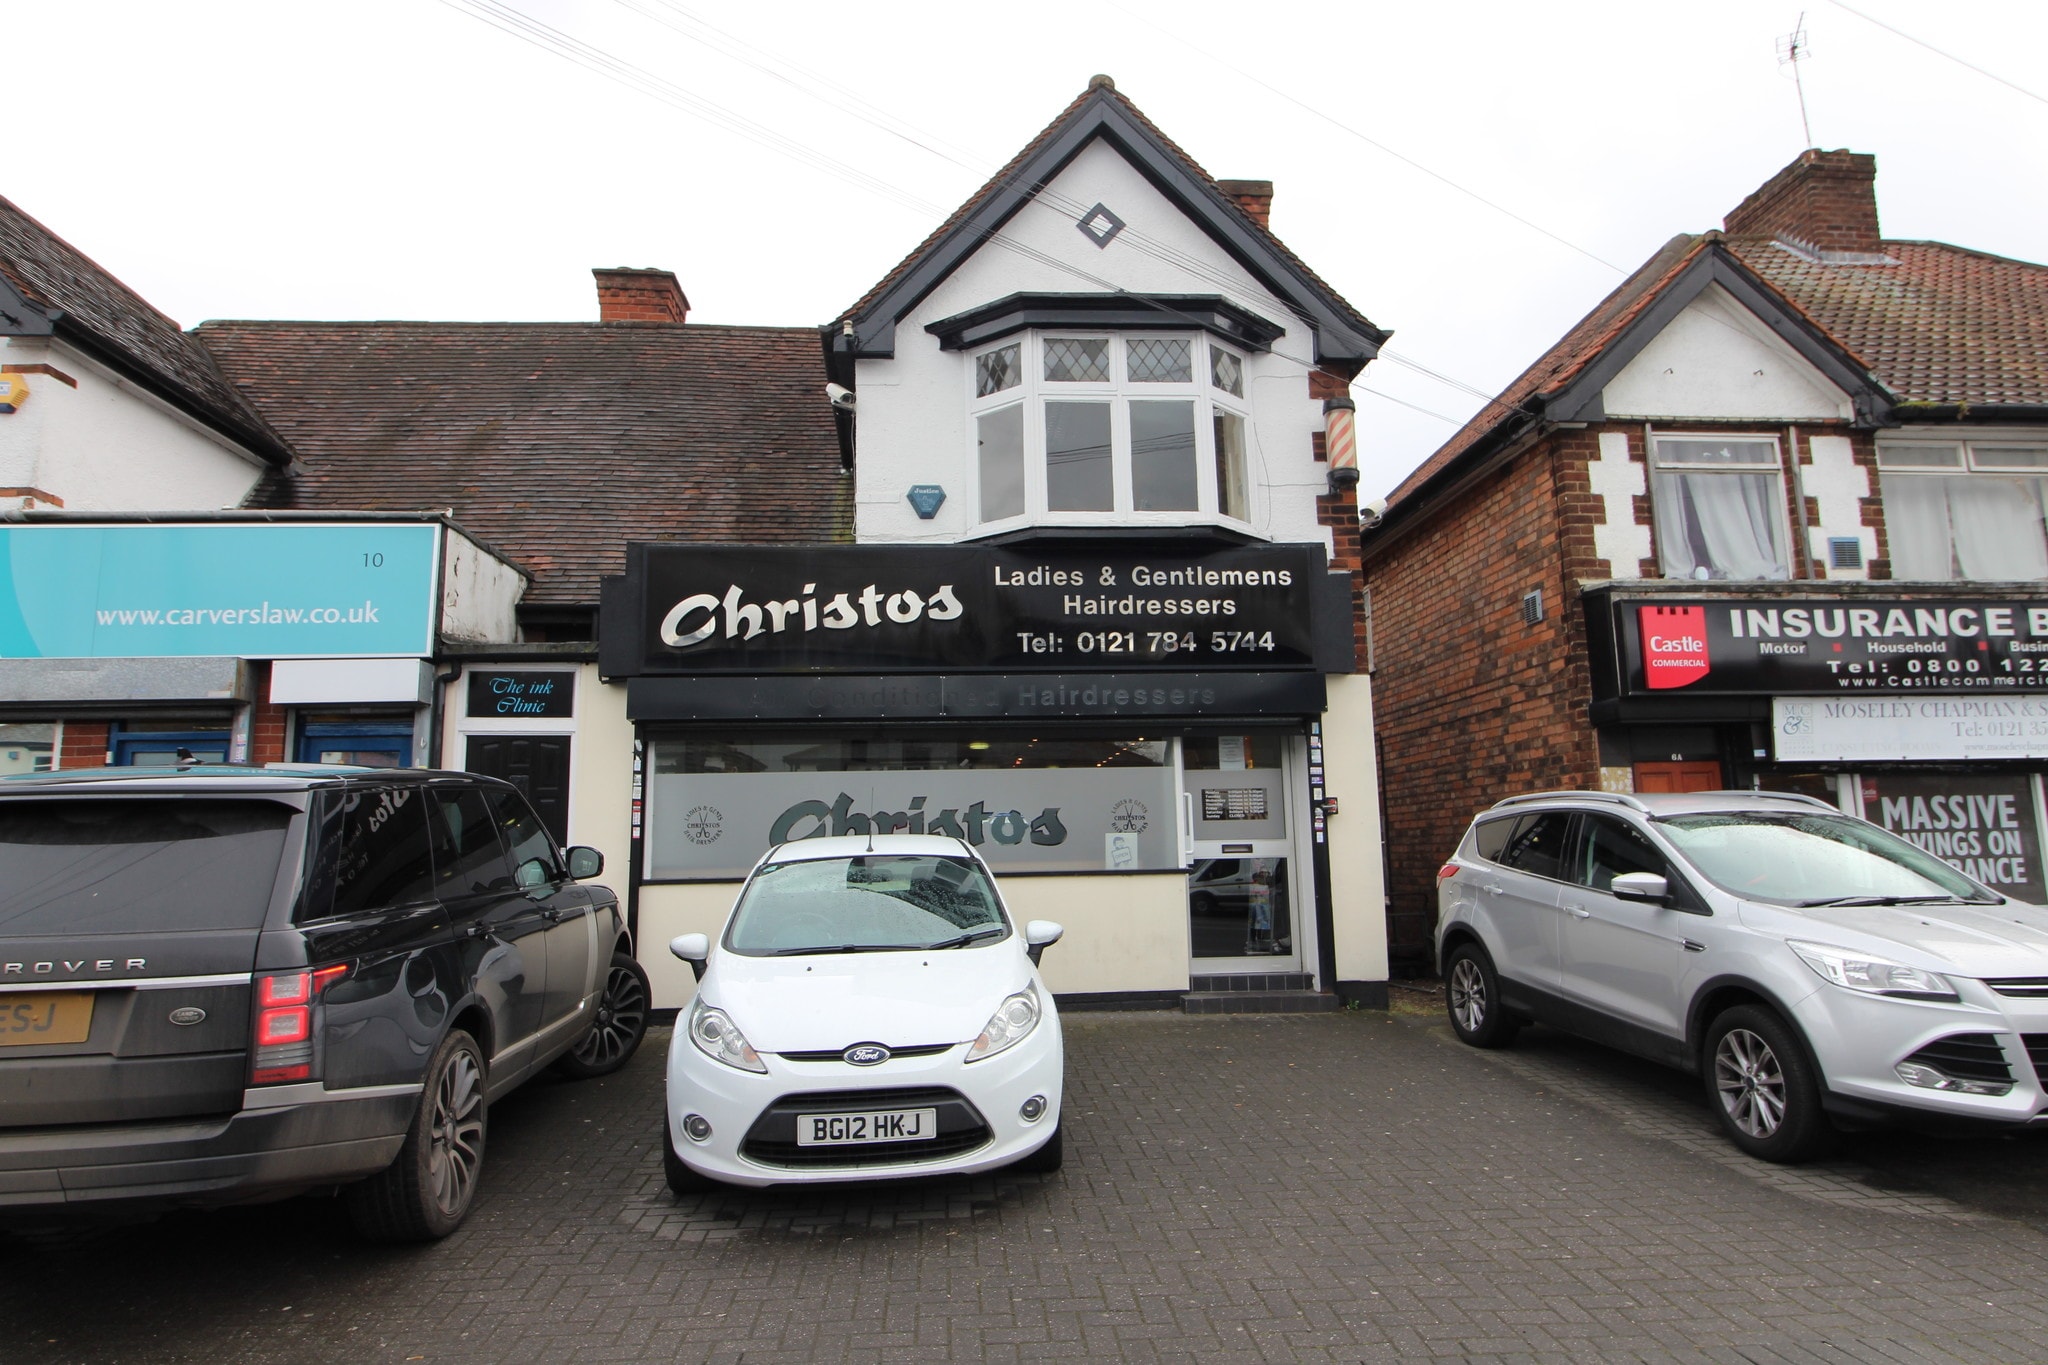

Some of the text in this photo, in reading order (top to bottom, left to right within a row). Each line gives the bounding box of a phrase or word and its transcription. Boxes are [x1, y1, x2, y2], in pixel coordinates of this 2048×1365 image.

[362, 552, 384, 568] 10
[994, 566, 1292, 586] Ladies & Gentlemens
[96, 600, 380, 625] www.carverslaw.co.uk
[1064, 595, 1237, 615] Hairdressers
[660, 583, 963, 647] Christos
[1729, 608, 2016, 637] INSURANCE
[1017, 631, 1275, 653] Tel: 0121 784 5744
[1650, 635, 1703, 652] Castle
[1759, 642, 1806, 654] Motor
[1867, 641, 1946, 653] Household
[1652, 659, 1706, 667] COMMERCIAL
[1826, 658, 2048, 673] Tel: 0800 122
[489, 677, 554, 694] The ink
[1019, 684, 1216, 706] Hairdressers
[497, 697, 546, 713] Clinic
[1825, 703, 1915, 719] MOSELEY
[1920, 702, 2016, 718] CHAPMAN
[2021, 702, 2034, 717] &
[1951, 721, 1983, 737] Tel:
[1988, 721, 2023, 736] 0121
[1671, 753, 1683, 761] 6A
[769, 792, 1068, 847] Christos
[1881, 795, 2019, 830] MASSIVE
[1987, 831, 2022, 856] ON
[4, 958, 147, 974] ROVER
[853, 1049, 879, 1061] Ford
[813, 1113, 920, 1141] BG12 HKJ
